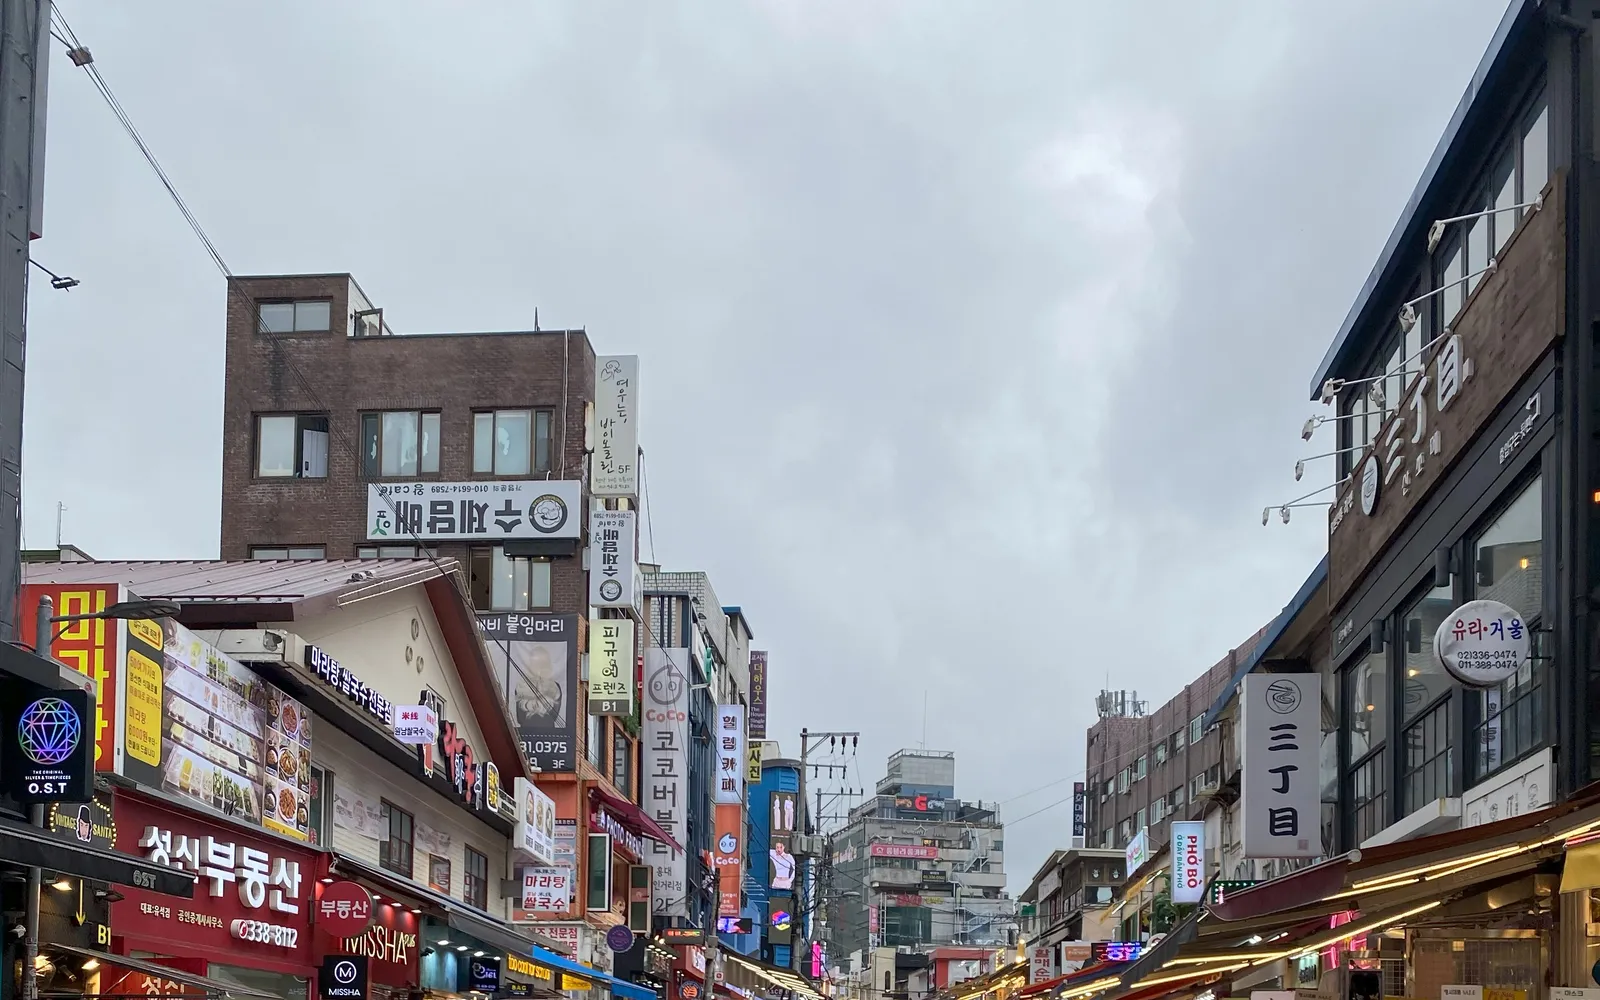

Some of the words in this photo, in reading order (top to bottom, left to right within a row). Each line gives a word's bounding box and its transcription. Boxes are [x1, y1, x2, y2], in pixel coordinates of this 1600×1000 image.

[1385, 334, 1464, 486] 三丁目
[600, 418, 616, 474] 바이올린
[618, 465, 631, 474] 5F
[413, 483, 424, 496] 왕
[431, 485, 488, 494] 010-6614-7589
[395, 499, 522, 534] 수제담배
[601, 529, 619, 577] 수제담배
[506, 614, 564, 635] 붙임머리
[602, 626, 619, 678] 피규어
[1457, 650, 1517, 660] 02)336-0474
[1458, 660, 1518, 670] 011-388-0474
[58, 590, 110, 762] 마라
[752, 663, 764, 704] 더하우스
[592, 682, 627, 695] 프렌즈
[602, 701, 617, 711] B1
[721, 715, 738, 792] 힐링카페
[552, 760, 565, 769] 3F
[1268, 723, 1299, 837] 三丁目
[28, 782, 67, 794] O.S.T
[92, 823, 113, 839] SANTA
[716, 857, 739, 865] CoCo
[133, 869, 156, 889] OST
[657, 866, 672, 877] 홍대
[525, 875, 566, 888] 마라탕
[321, 900, 368, 919] 부동산
[524, 897, 565, 909] 쌀국수
[655, 897, 674, 912] 2F
[98, 924, 111, 946] B1
[248, 920, 298, 949] 338-8112
[549, 927, 578, 939] 전문점
[328, 988, 361, 996] MISSHA
